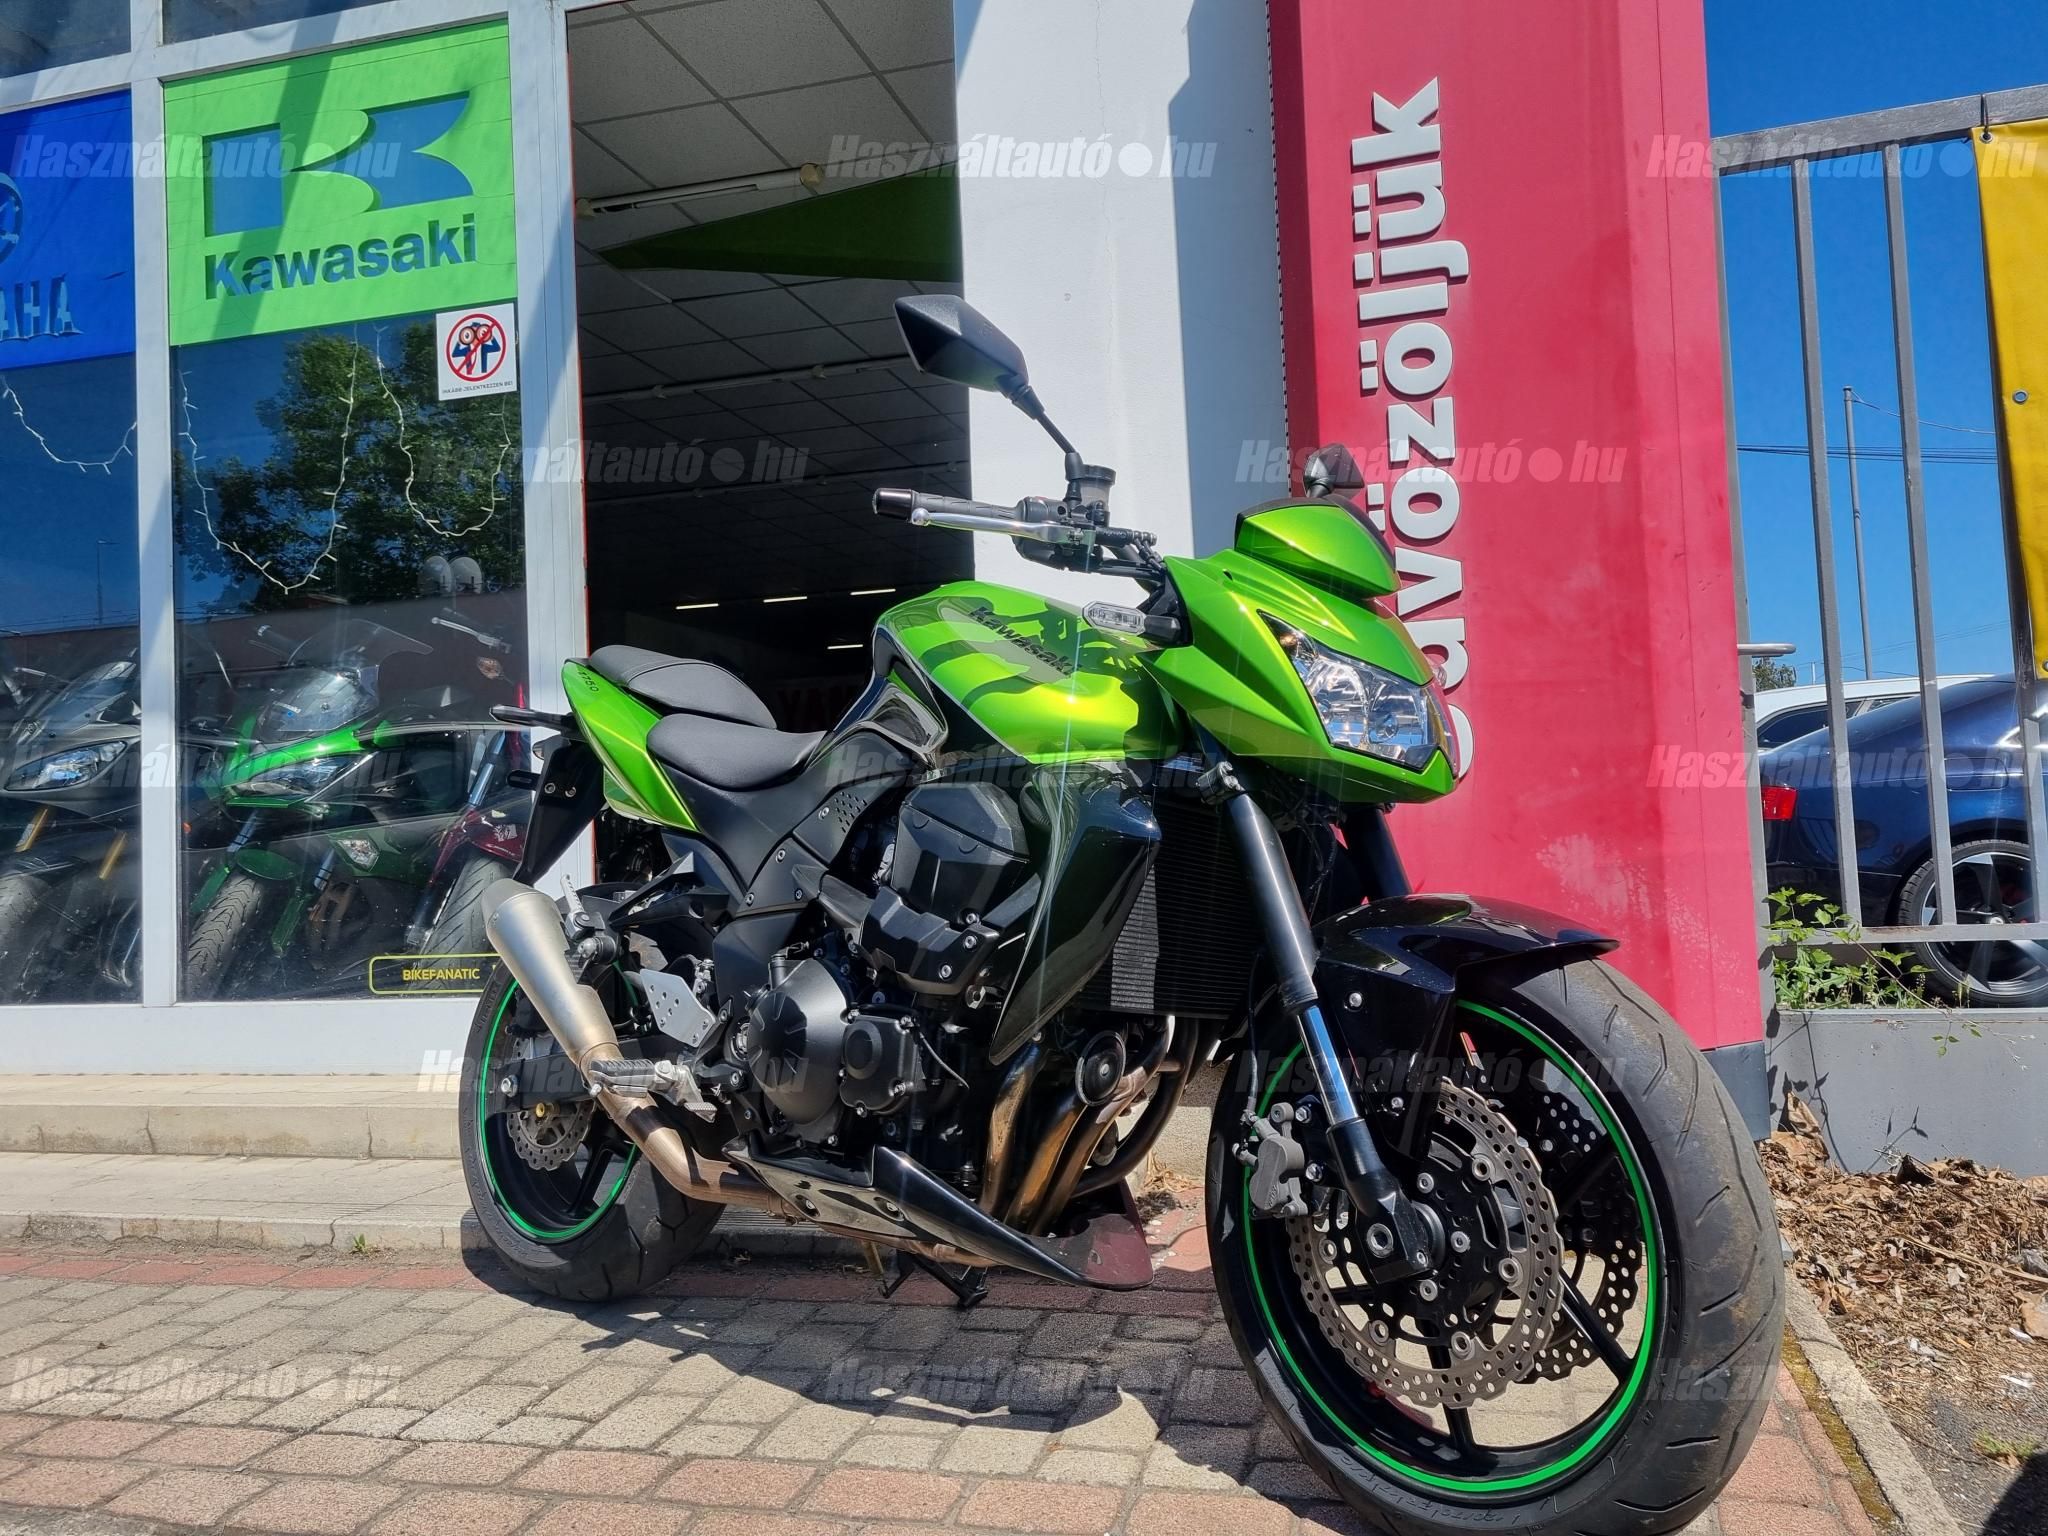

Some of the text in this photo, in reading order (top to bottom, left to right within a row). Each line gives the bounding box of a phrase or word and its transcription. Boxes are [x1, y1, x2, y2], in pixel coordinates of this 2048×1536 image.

[204, 212, 476, 300] Kawasaki
[1351, 76, 1474, 778] dvözöljük
[402, 968, 480, 981] BIKEFANATIC
